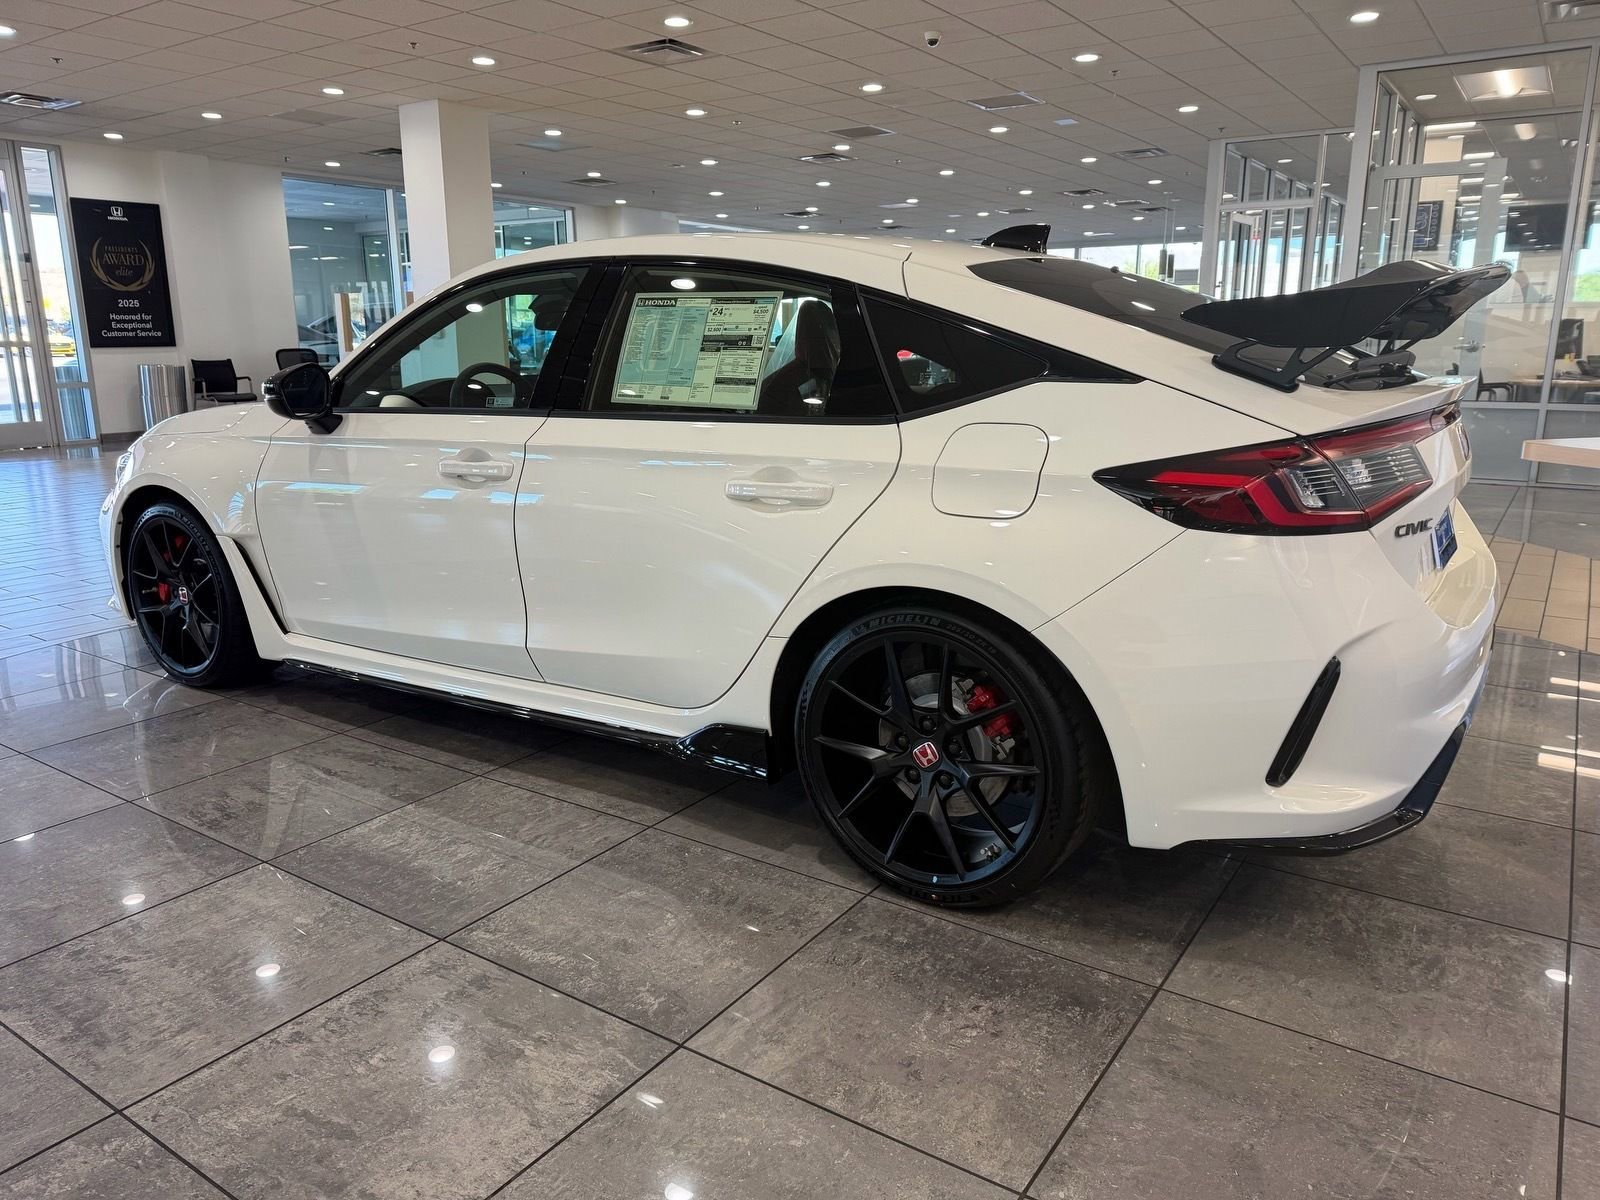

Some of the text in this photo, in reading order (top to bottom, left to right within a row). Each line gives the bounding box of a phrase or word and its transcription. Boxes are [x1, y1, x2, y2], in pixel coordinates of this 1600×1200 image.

[102, 252, 145, 266] AWARD
[117, 299, 140, 308] 2025
[712, 307, 724, 316] 24
[109, 313, 153, 321] Honored for
[111, 321, 153, 329] Exceptional
[101, 329, 162, 338] Customer Service
[1394, 517, 1434, 538] CIVIC
[868, 614, 942, 629] MICHELIN
